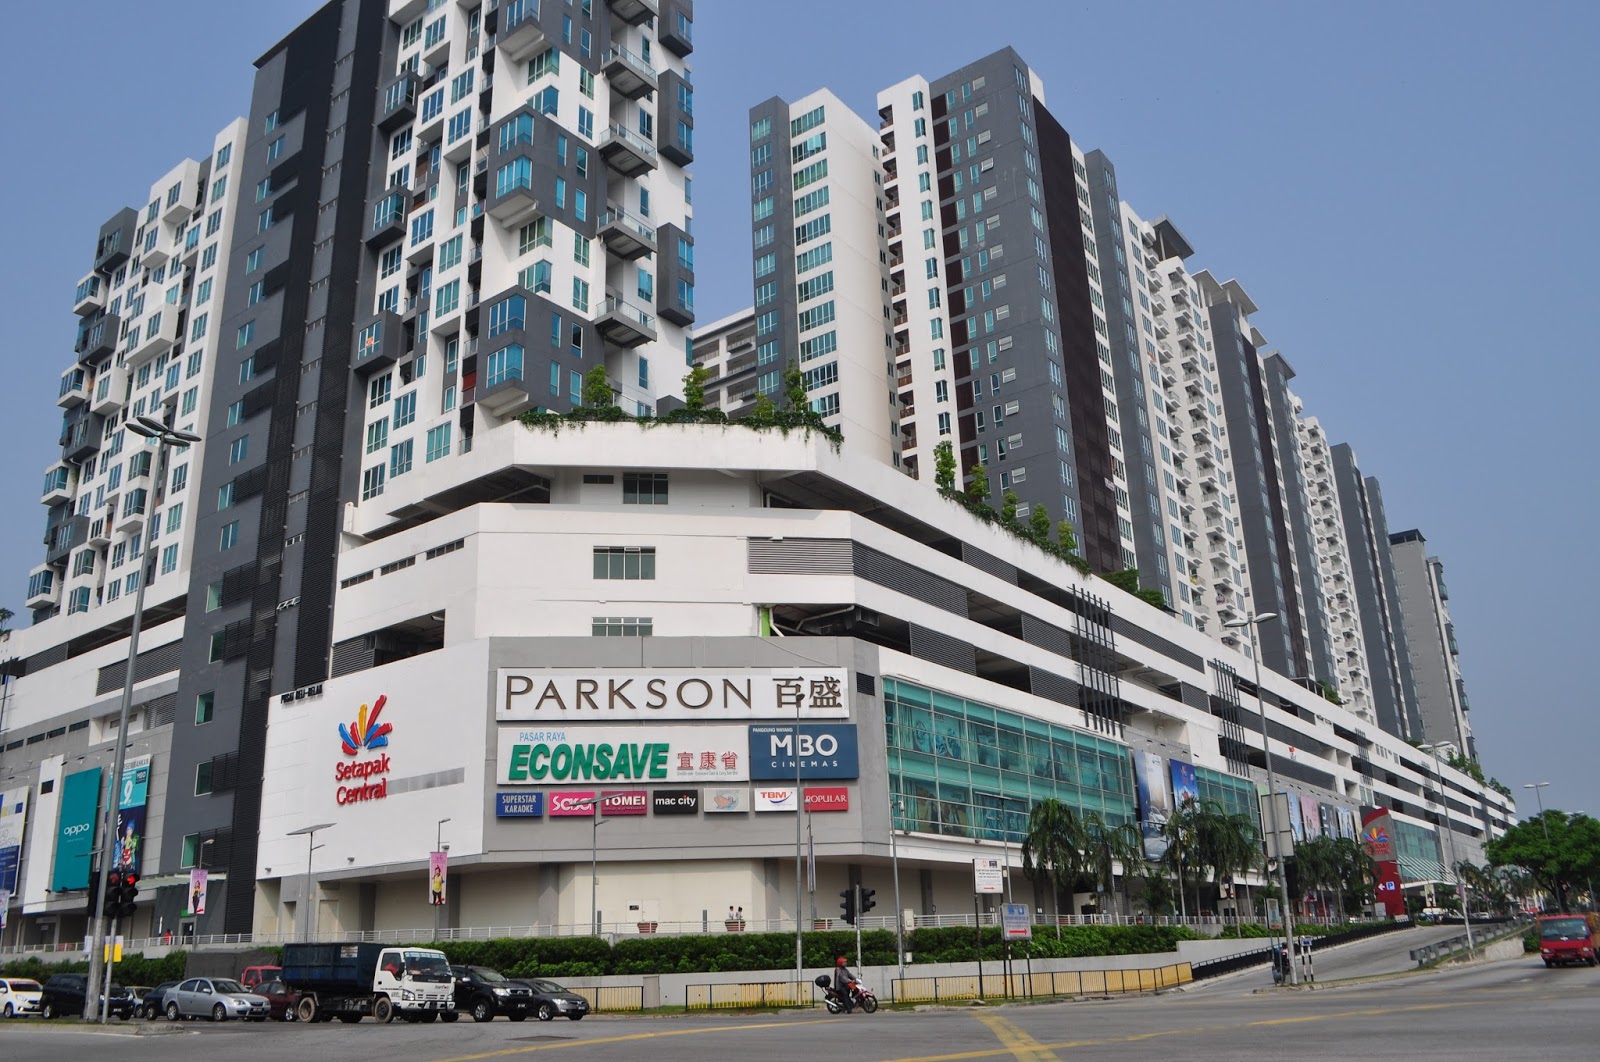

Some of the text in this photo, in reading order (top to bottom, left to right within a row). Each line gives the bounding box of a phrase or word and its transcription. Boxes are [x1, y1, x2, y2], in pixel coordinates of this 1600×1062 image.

[505, 675, 752, 710] PARKSON
[772, 675, 842, 708] 百盛
[519, 731, 566, 742] PASAR RAYA
[770, 734, 838, 756] MBO
[335, 752, 391, 782] Setapak
[508, 743, 670, 781] ECONSAVE
[676, 751, 738, 771] 宜康省
[771, 760, 838, 768] CINEMAS
[336, 777, 387, 806] Central
[760, 791, 787, 799] TBM
[805, 794, 847, 803] POPULAR
[502, 795, 537, 804] SUPERSTAR
[655, 793, 696, 807] mac city
[504, 804, 534, 813] KARAOKE
[63, 823, 90, 837] oppo
